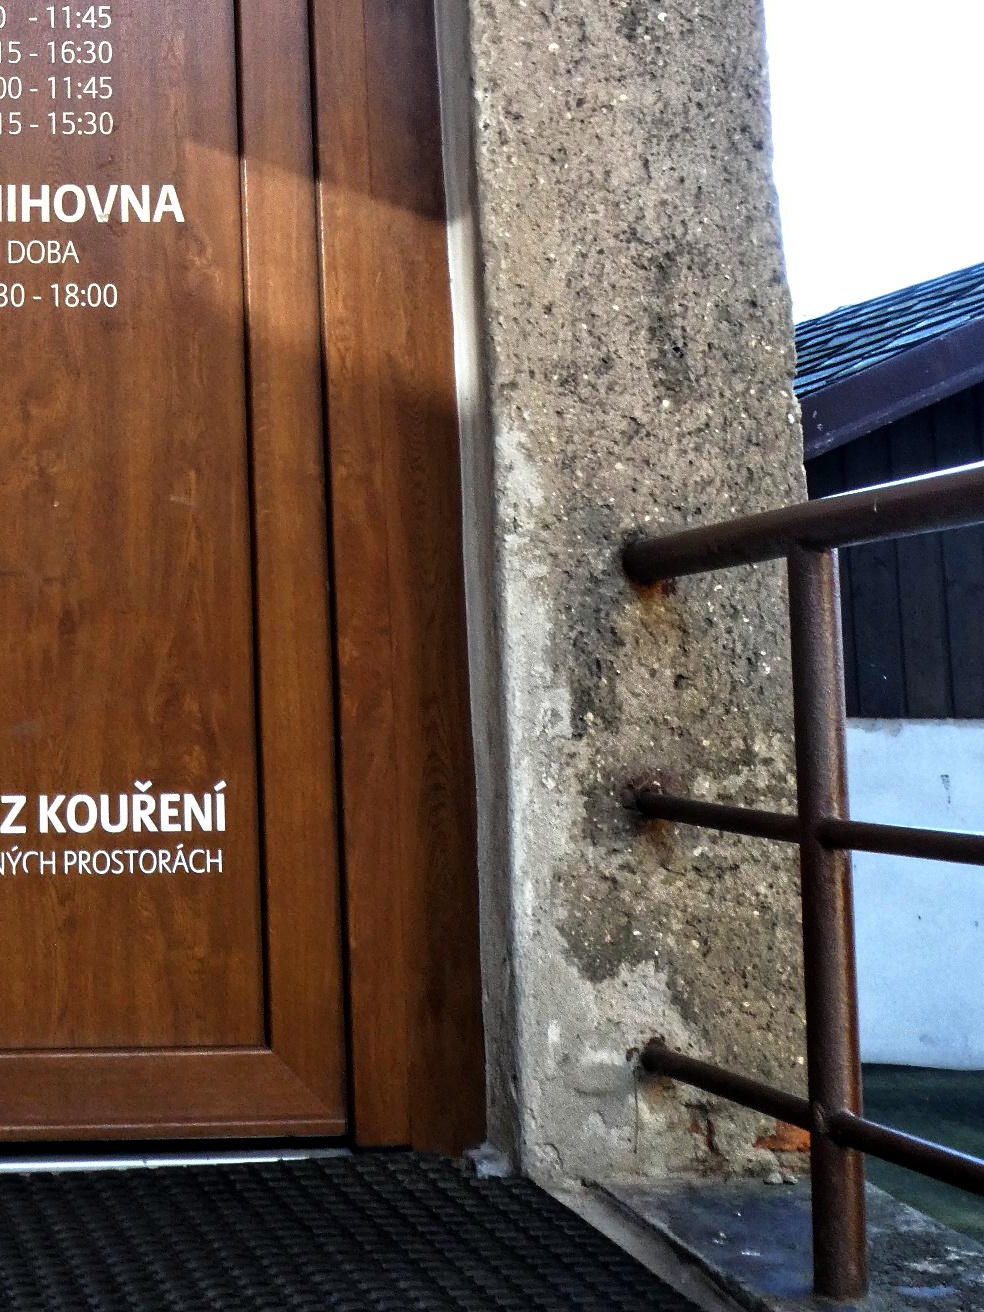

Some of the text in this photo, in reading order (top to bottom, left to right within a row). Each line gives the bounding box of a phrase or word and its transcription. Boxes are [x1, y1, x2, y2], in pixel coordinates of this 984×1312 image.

[46, 3, 112, 29] 11:45
[47, 40, 113, 65] 16:30
[47, 75, 113, 100] 11:45
[47, 111, 114, 136] 15:30
[7, 239, 80, 264] DOBA
[50, 282, 118, 308] 18:00
[39, 780, 227, 833] KOUŘENÍ
[65, 843, 223, 875] PROSTORÁCH
